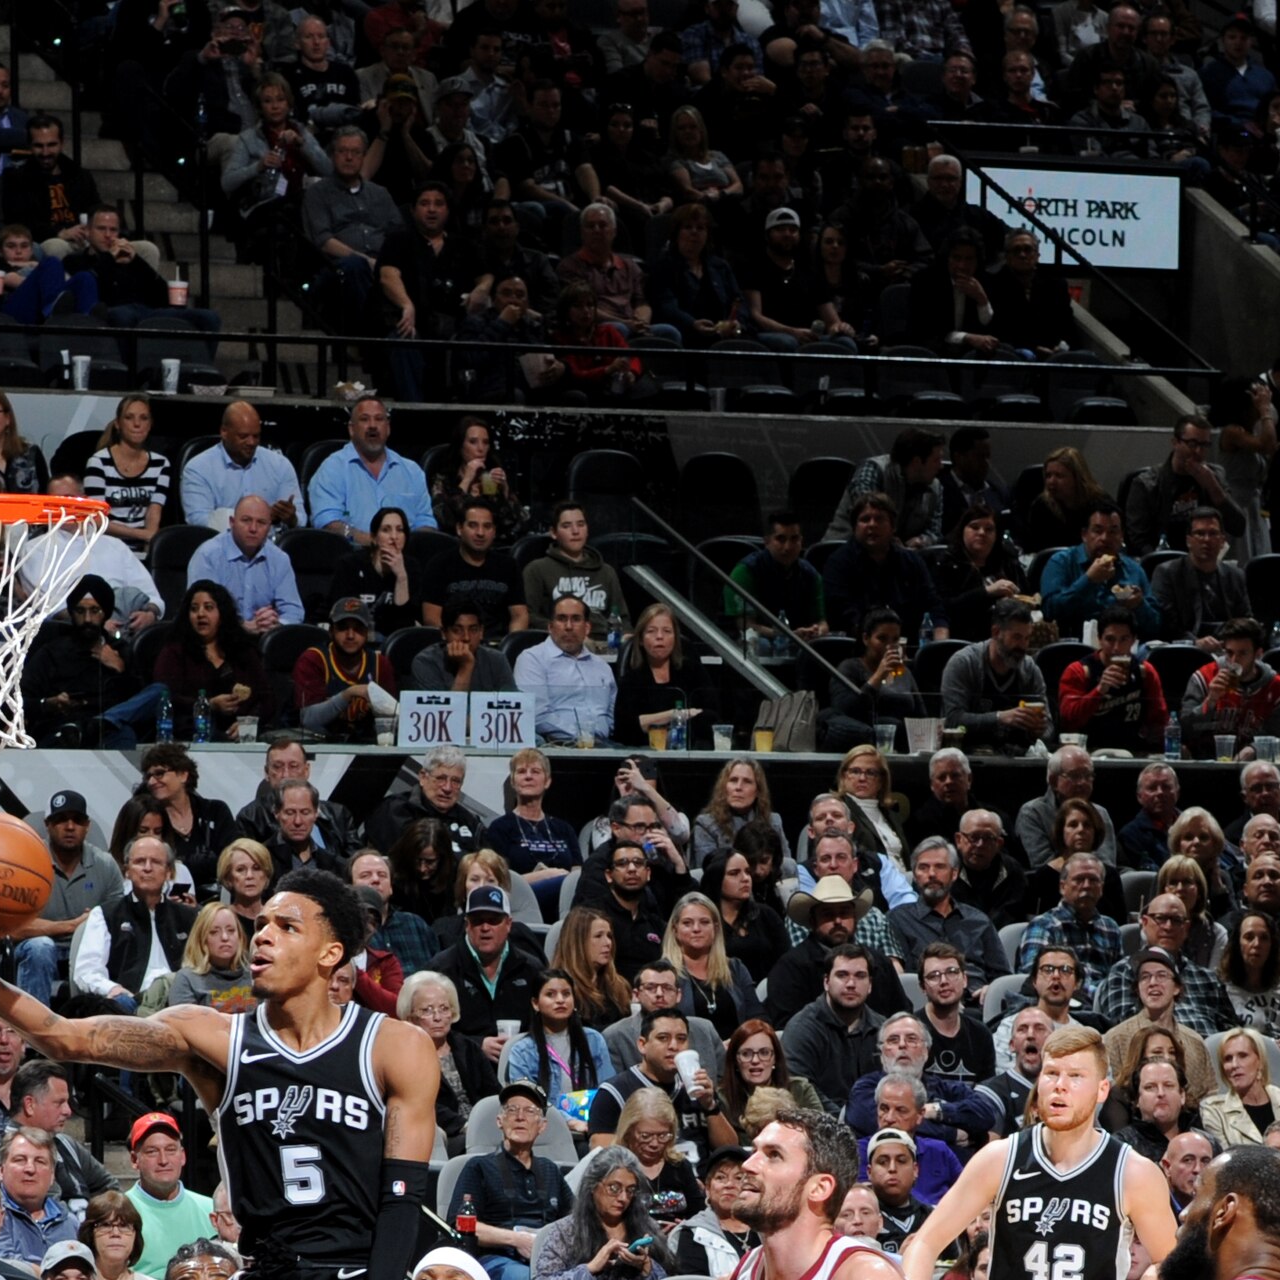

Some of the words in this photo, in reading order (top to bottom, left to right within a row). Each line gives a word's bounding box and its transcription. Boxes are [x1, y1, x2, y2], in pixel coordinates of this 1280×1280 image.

[1084, 199, 1141, 221] PARK
[407, 709, 453, 742] 30K
[479, 711, 523, 744] 30K
[233, 1086, 369, 1138] SPURS
[279, 1144, 326, 1206] 5
[1006, 1196, 1111, 1235] SPURS
